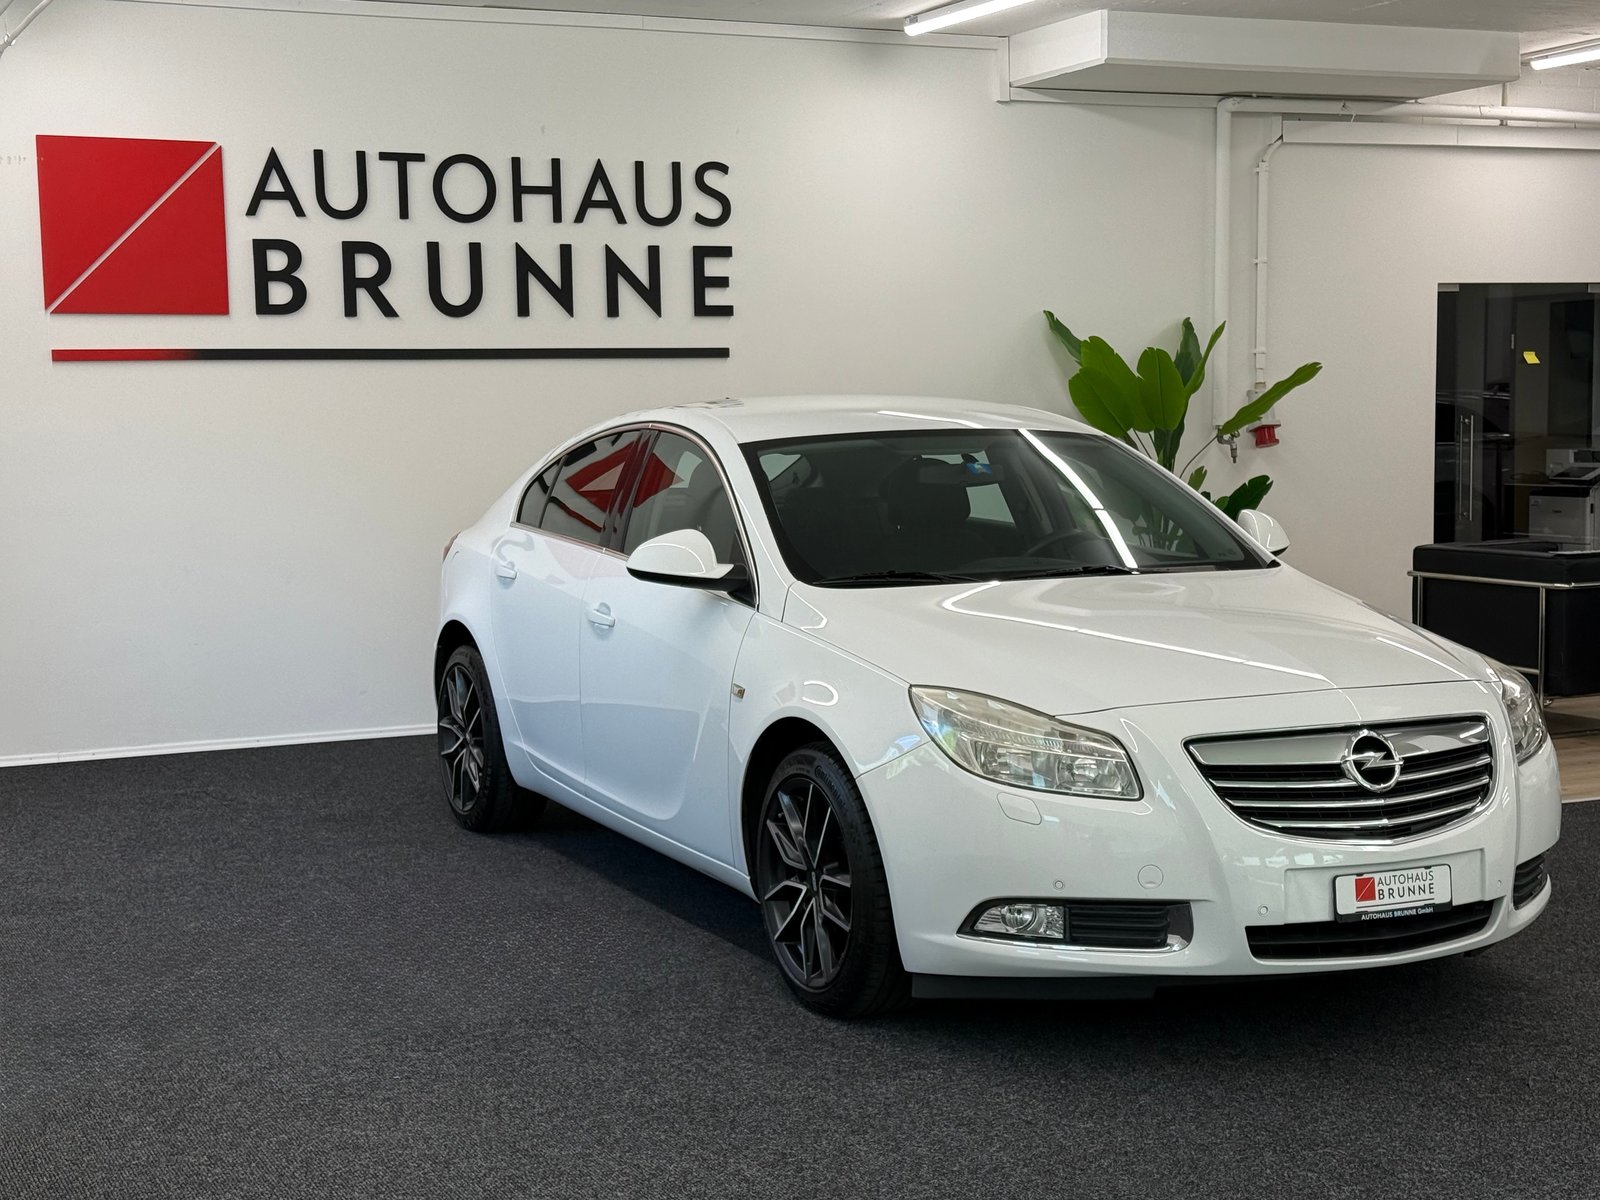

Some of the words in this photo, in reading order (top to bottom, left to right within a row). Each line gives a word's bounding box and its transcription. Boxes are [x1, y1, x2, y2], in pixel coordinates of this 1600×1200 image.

[245, 146, 732, 228] AUTOHAUS
[251, 238, 735, 319] BRUNNE
[1377, 870, 1434, 887] AUTOHAUS
[1377, 882, 1435, 900] BRUNNE
[1361, 911, 1393, 920] AUTOHAUS
[1393, 908, 1417, 918] BRUNNE
[1417, 906, 1434, 915] GmbH
